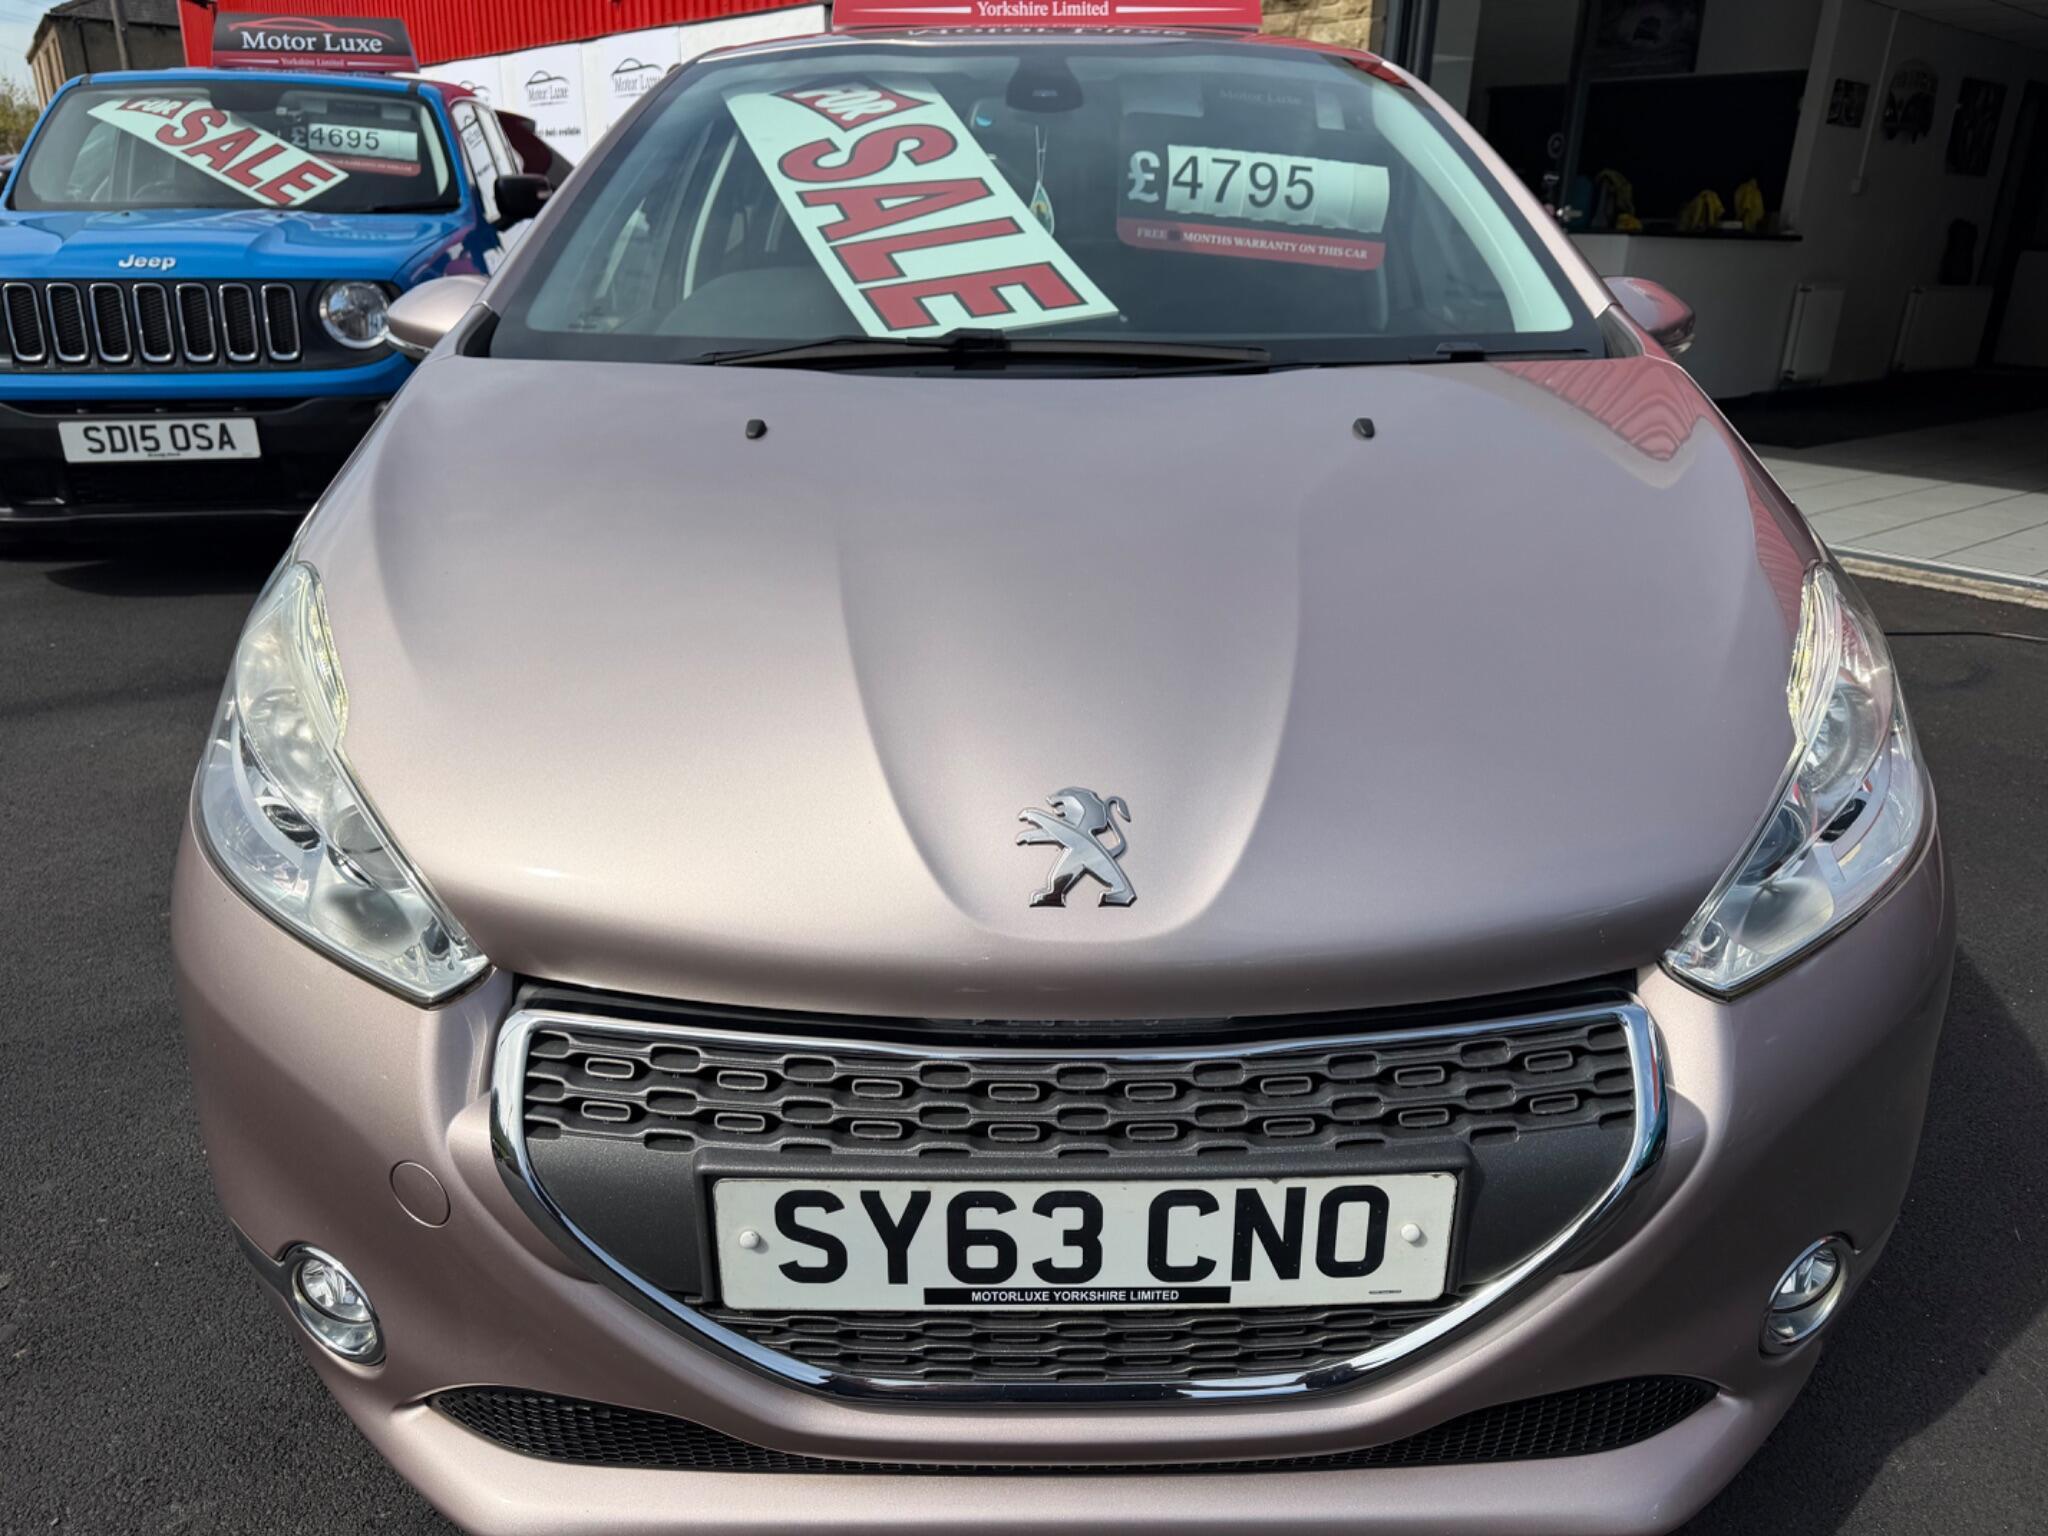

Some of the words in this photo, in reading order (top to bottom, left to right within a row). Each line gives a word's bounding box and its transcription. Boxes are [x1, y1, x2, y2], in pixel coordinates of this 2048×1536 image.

[977, 1, 1048, 17] Yorkshire
[1052, 1, 1110, 17] Limited
[241, 31, 317, 51] Motor
[323, 33, 383, 53] Luxe
[128, 98, 174, 116] FOR
[793, 86, 897, 121] FOR
[155, 108, 337, 206] SALE
[777, 123, 1088, 332] SALE
[1136, 227, 1168, 240] FREE
[1183, 231, 1233, 247] MONTHS
[1233, 236, 1298, 253] WARRANTY
[1298, 243, 1317, 254] ON
[1317, 245, 1343, 257] THIS
[1343, 248, 1368, 259] CAR
[118, 254, 176, 271] Jeep
[83, 424, 161, 454] SD15
[169, 422, 237, 452] OSA
[774, 1190, 1104, 1285] SY63
[1147, 1184, 1391, 1282] CNO
[971, 1290, 1050, 1303] MOTORLUXE
[1053, 1290, 1127, 1302] YORKSHIRE
[1130, 1289, 1180, 1301] LIMITED
